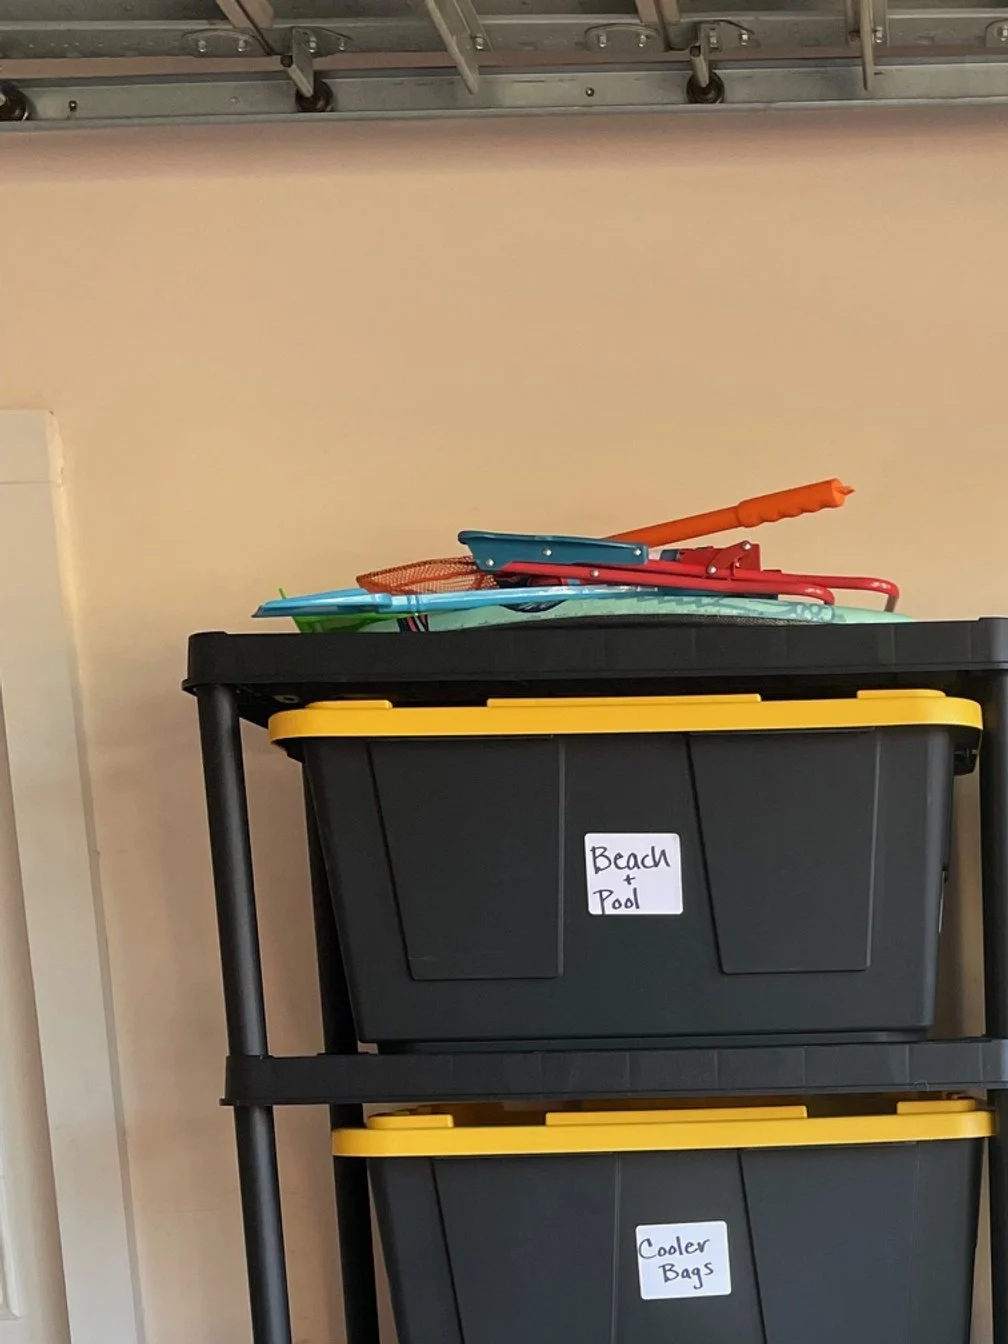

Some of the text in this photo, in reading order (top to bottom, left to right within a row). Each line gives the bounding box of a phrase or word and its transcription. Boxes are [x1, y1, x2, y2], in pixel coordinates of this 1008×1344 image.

[590, 845, 671, 875] Beach
[623, 874, 636, 886] +
[592, 887, 640, 914] Pool
[639, 1236, 710, 1260] Cooler
[658, 1262, 714, 1290] Bags
